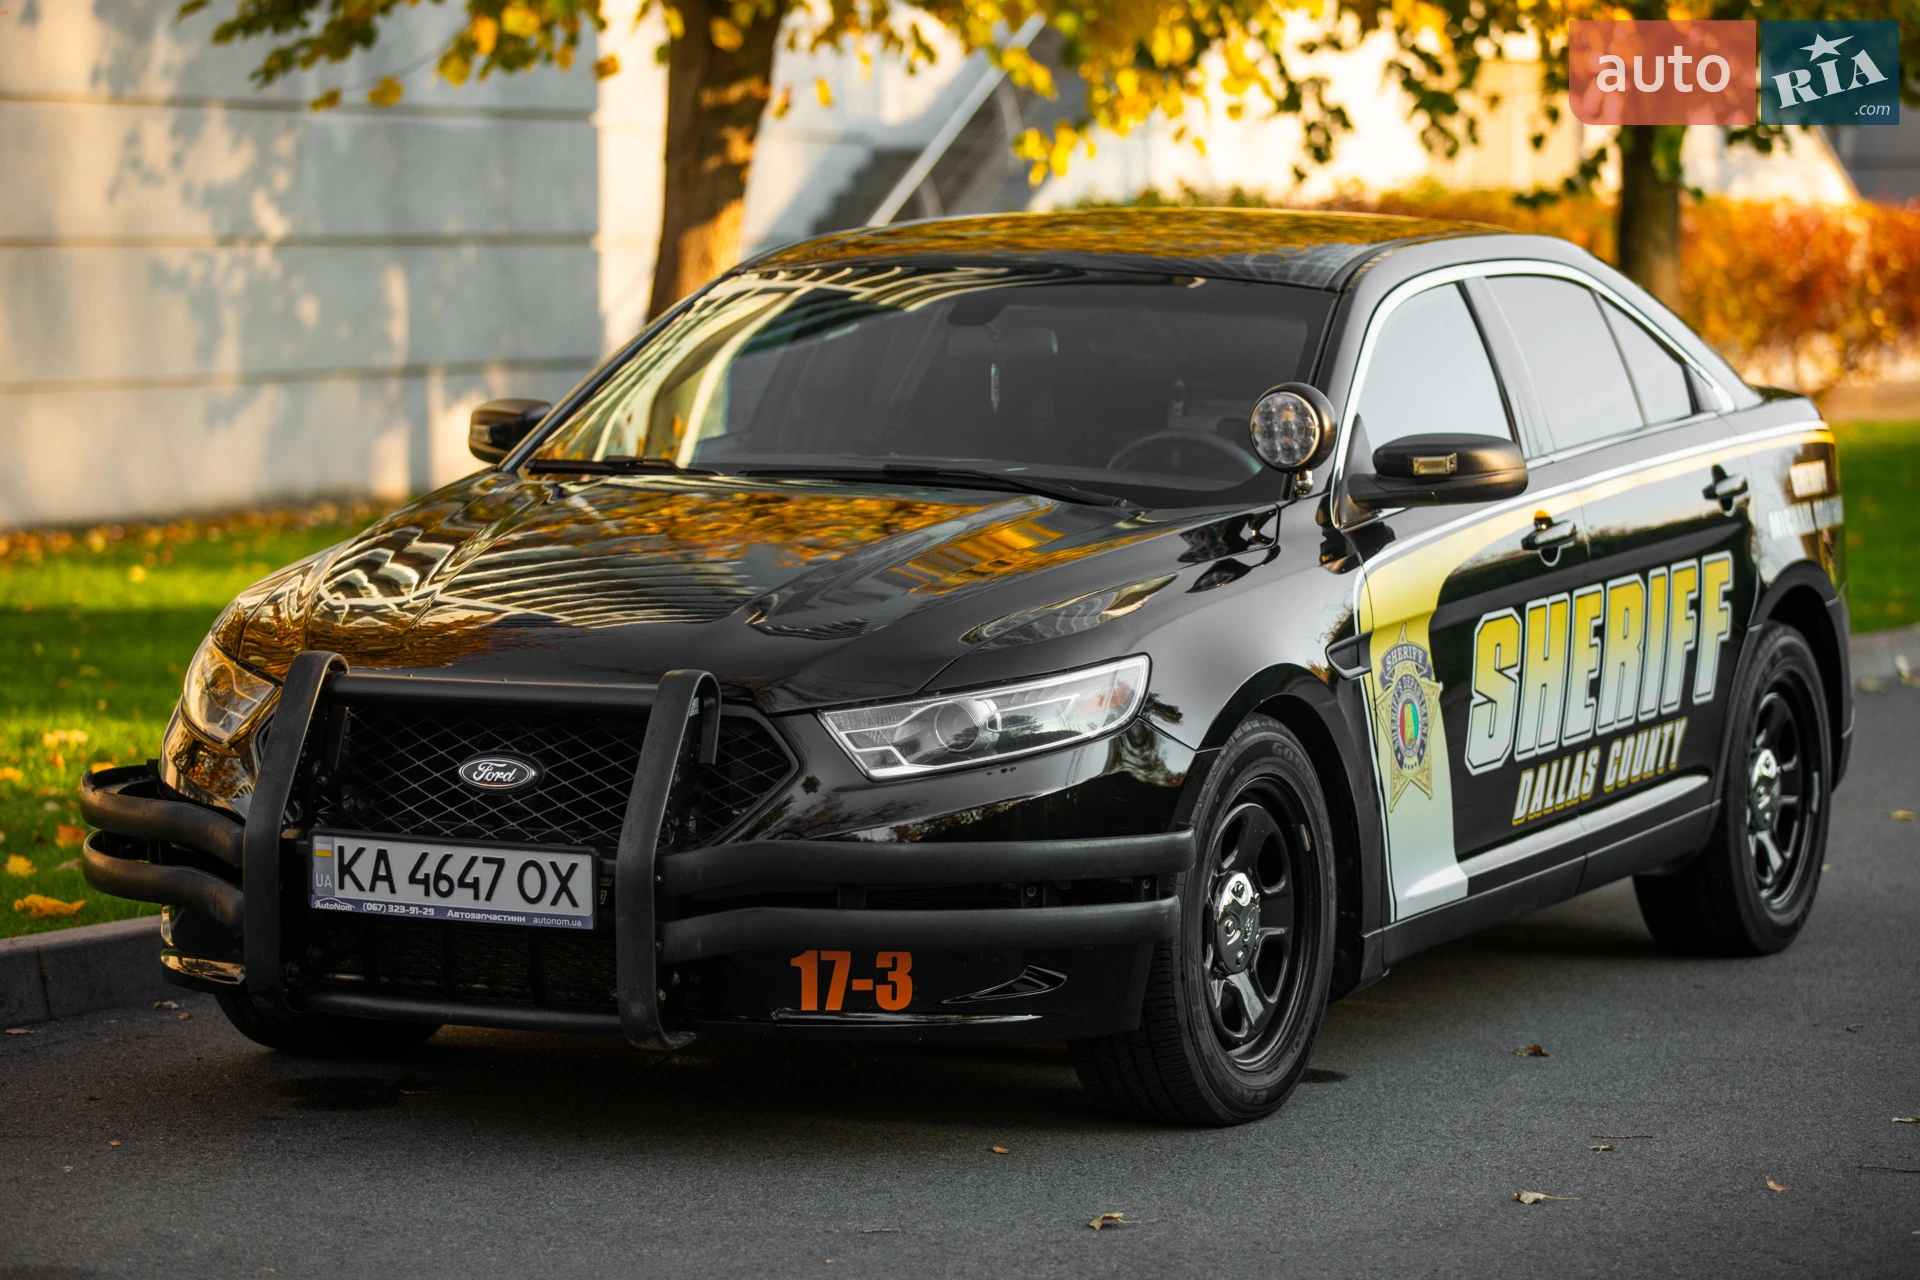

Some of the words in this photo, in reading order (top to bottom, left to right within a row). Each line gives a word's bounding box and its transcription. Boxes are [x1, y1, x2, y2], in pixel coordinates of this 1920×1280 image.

[1386, 645, 1424, 671] SHERIFF
[1465, 550, 1733, 776] SHERIFF
[473, 762, 517, 782] Ford
[1512, 746, 1600, 826] DALLAS
[1603, 717, 1688, 792] COUNTY
[316, 873, 332, 889] UA
[337, 845, 396, 894] KA
[408, 851, 505, 902] 4647
[517, 859, 579, 908] OX
[315, 902, 352, 912] AutoNom
[363, 902, 386, 913] (067)
[388, 905, 435, 916] 323-91-29
[447, 909, 526, 923] Автозапчастини
[533, 916, 582, 927] autonom.ua
[790, 950, 913, 1011] 17-3
